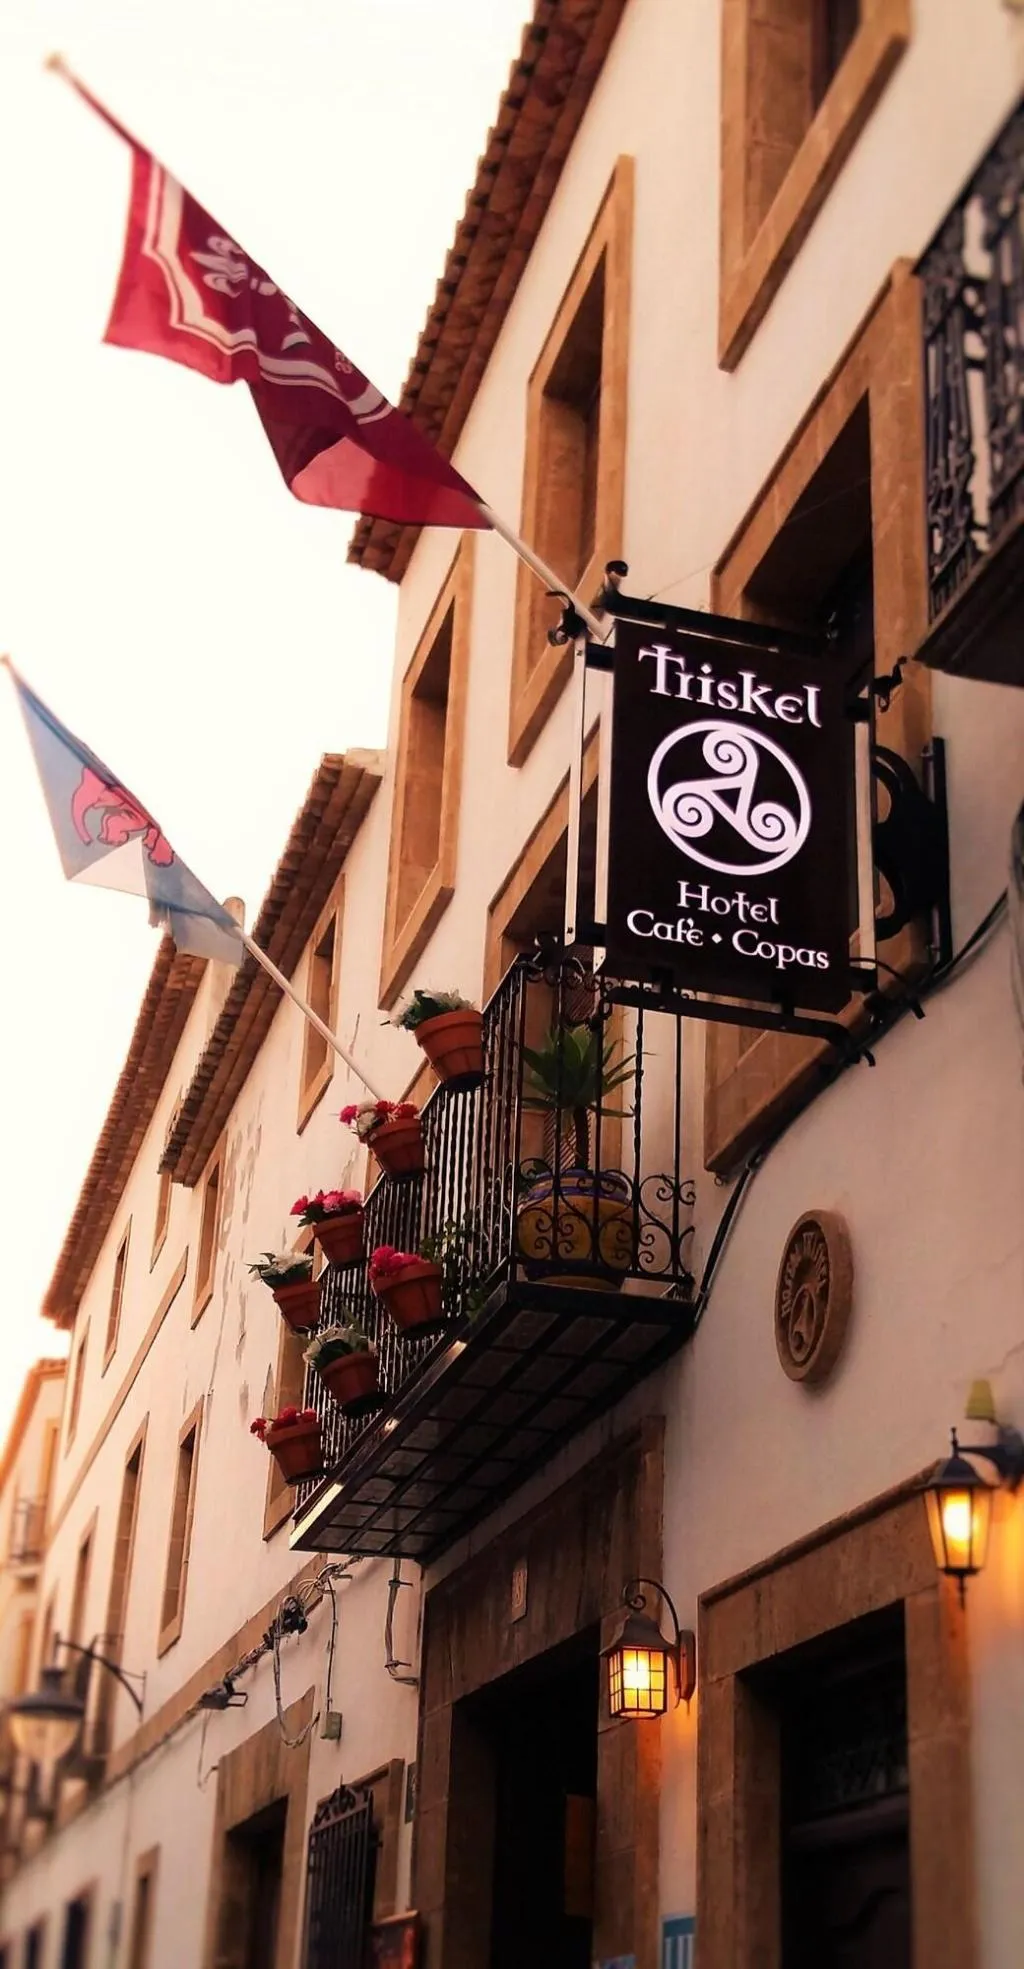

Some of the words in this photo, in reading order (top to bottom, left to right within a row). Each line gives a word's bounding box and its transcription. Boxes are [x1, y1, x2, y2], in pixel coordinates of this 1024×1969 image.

[637, 644, 822, 728] Triskel
[677, 880, 780, 925] Hotel
[731, 929, 830, 970] Copas
